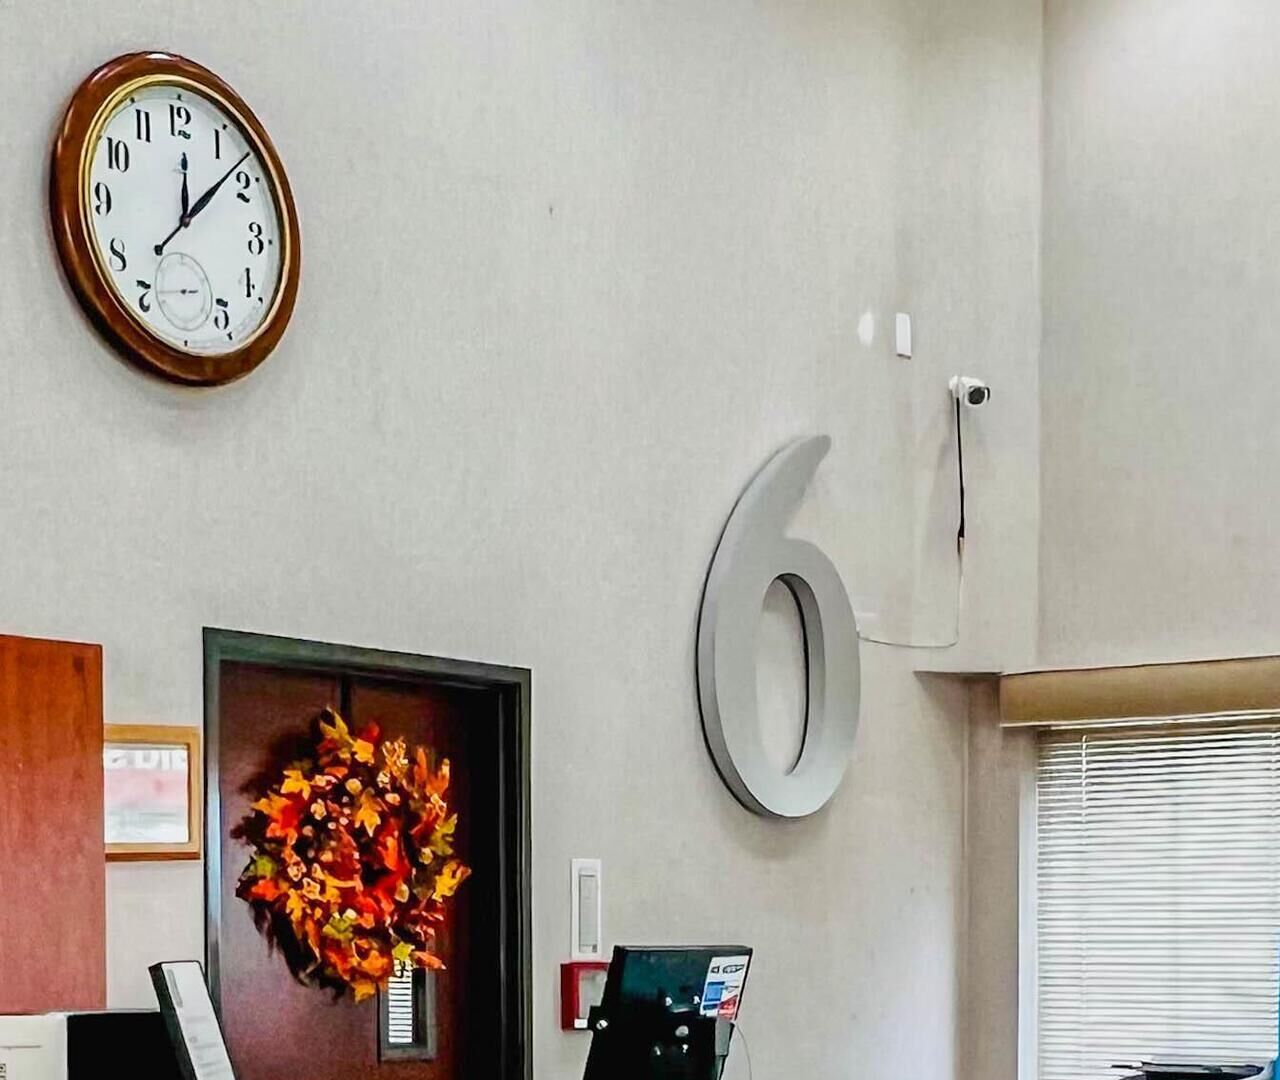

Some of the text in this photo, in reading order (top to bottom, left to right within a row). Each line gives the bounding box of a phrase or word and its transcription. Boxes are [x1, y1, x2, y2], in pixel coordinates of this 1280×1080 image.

[135, 108, 151, 143] 11
[169, 103, 192, 140] 12
[106, 136, 130, 172] 10
[214, 128, 221, 160] 1
[94, 182, 112, 216] 9
[236, 171, 251, 203] 2
[109, 237, 127, 272] 8
[247, 221, 264, 255] 3
[239, 267, 255, 297] 4
[214, 297, 229, 331] 5
[696, 434, 861, 818] 6
